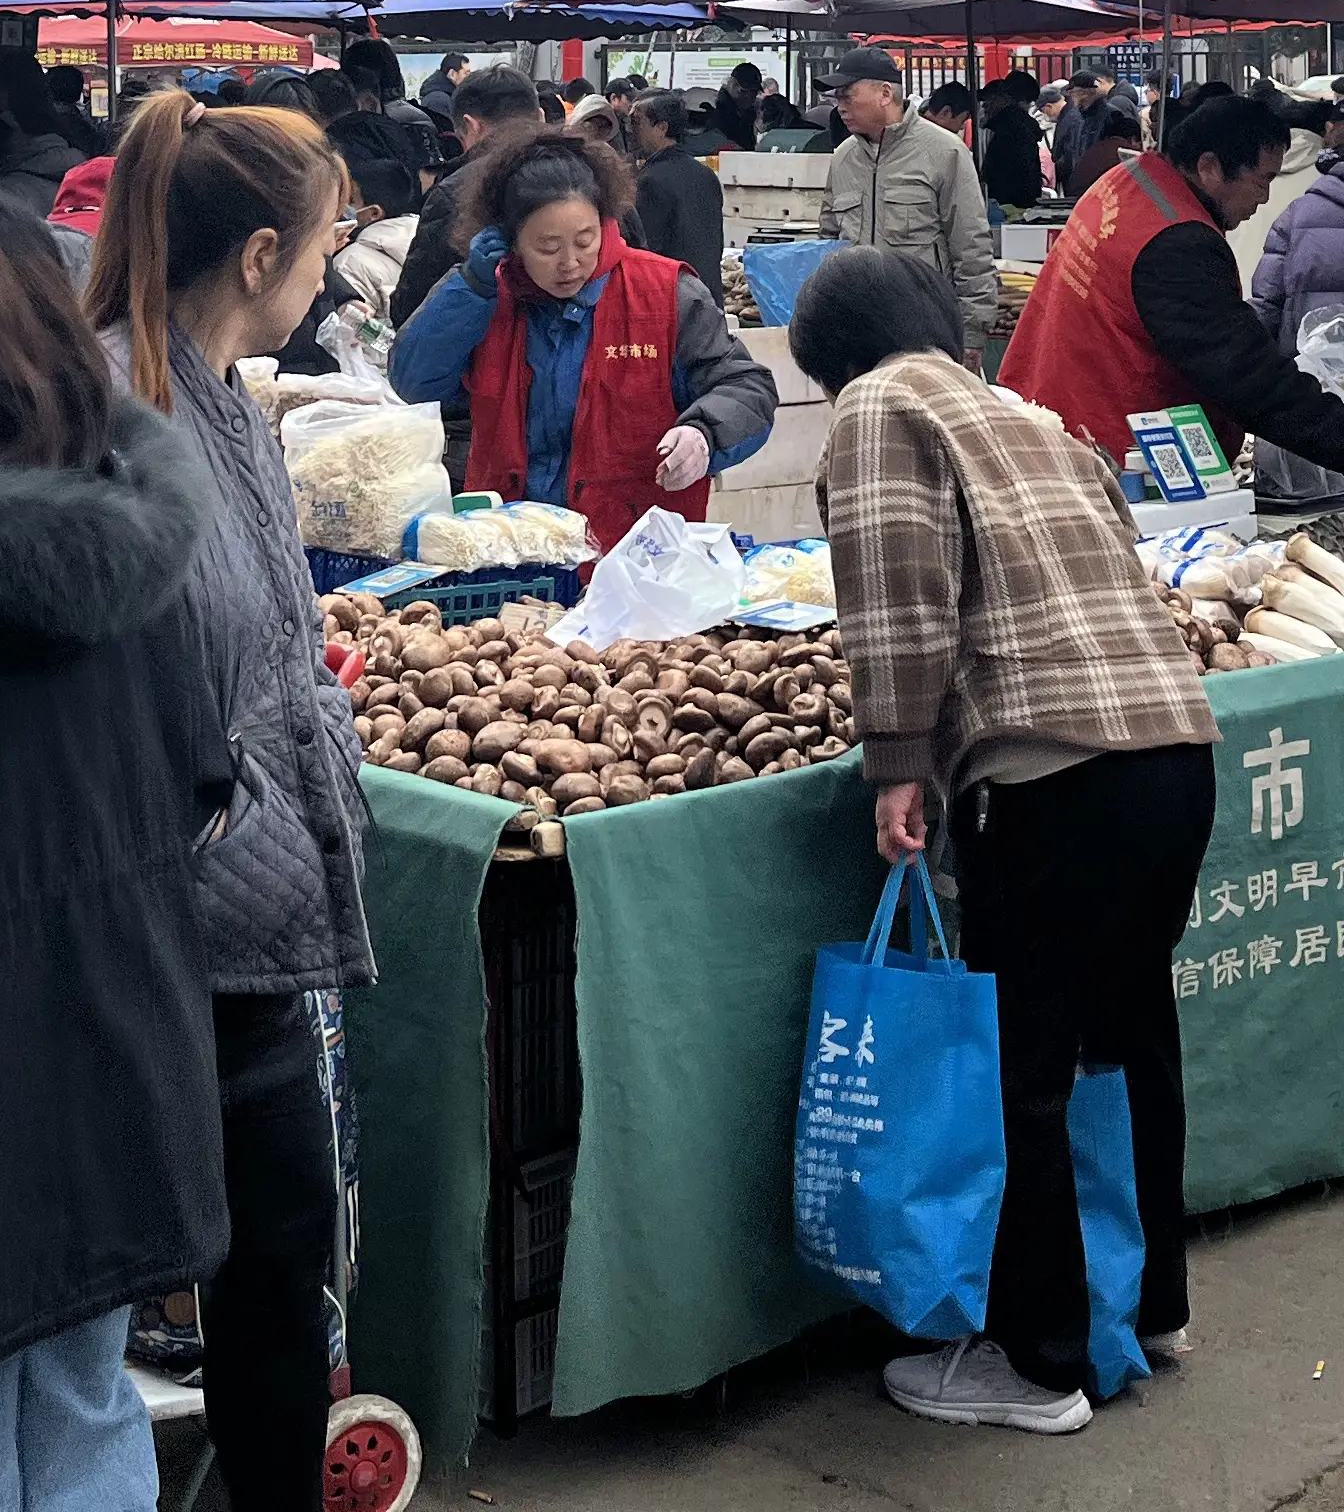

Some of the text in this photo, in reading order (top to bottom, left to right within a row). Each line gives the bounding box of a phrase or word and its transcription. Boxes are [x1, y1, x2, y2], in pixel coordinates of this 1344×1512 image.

[604, 343, 658, 360] 文华市场
[1242, 726, 1311, 841] 市
